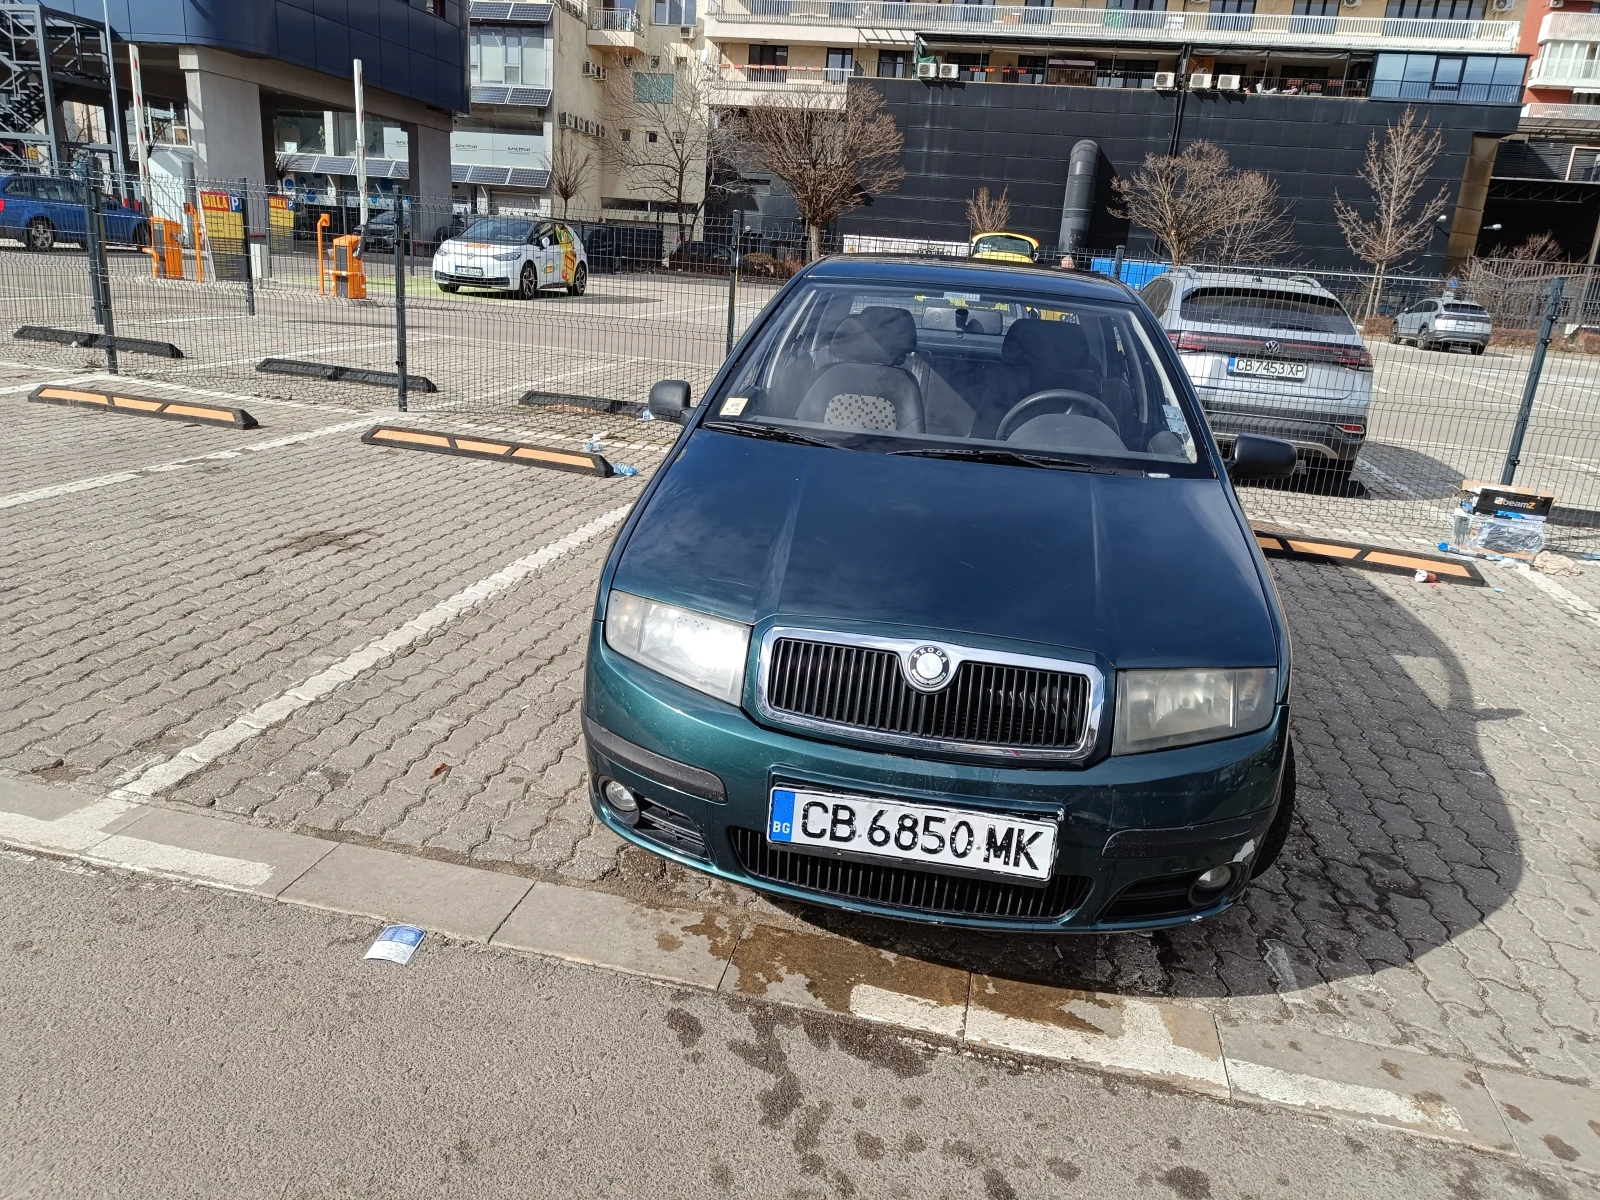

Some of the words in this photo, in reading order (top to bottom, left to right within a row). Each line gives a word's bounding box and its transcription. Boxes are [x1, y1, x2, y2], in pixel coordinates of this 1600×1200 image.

[203, 193, 229, 209] BILLA
[231, 196, 239, 210] P
[269, 198, 287, 209] BILLA
[1236, 359, 1253, 371] CB
[1254, 360, 1285, 374] 7453
[1287, 363, 1304, 376] XP
[772, 820, 791, 834] BG
[801, 801, 857, 843] CB
[867, 809, 974, 859] 6850
[983, 824, 1043, 871] MK
